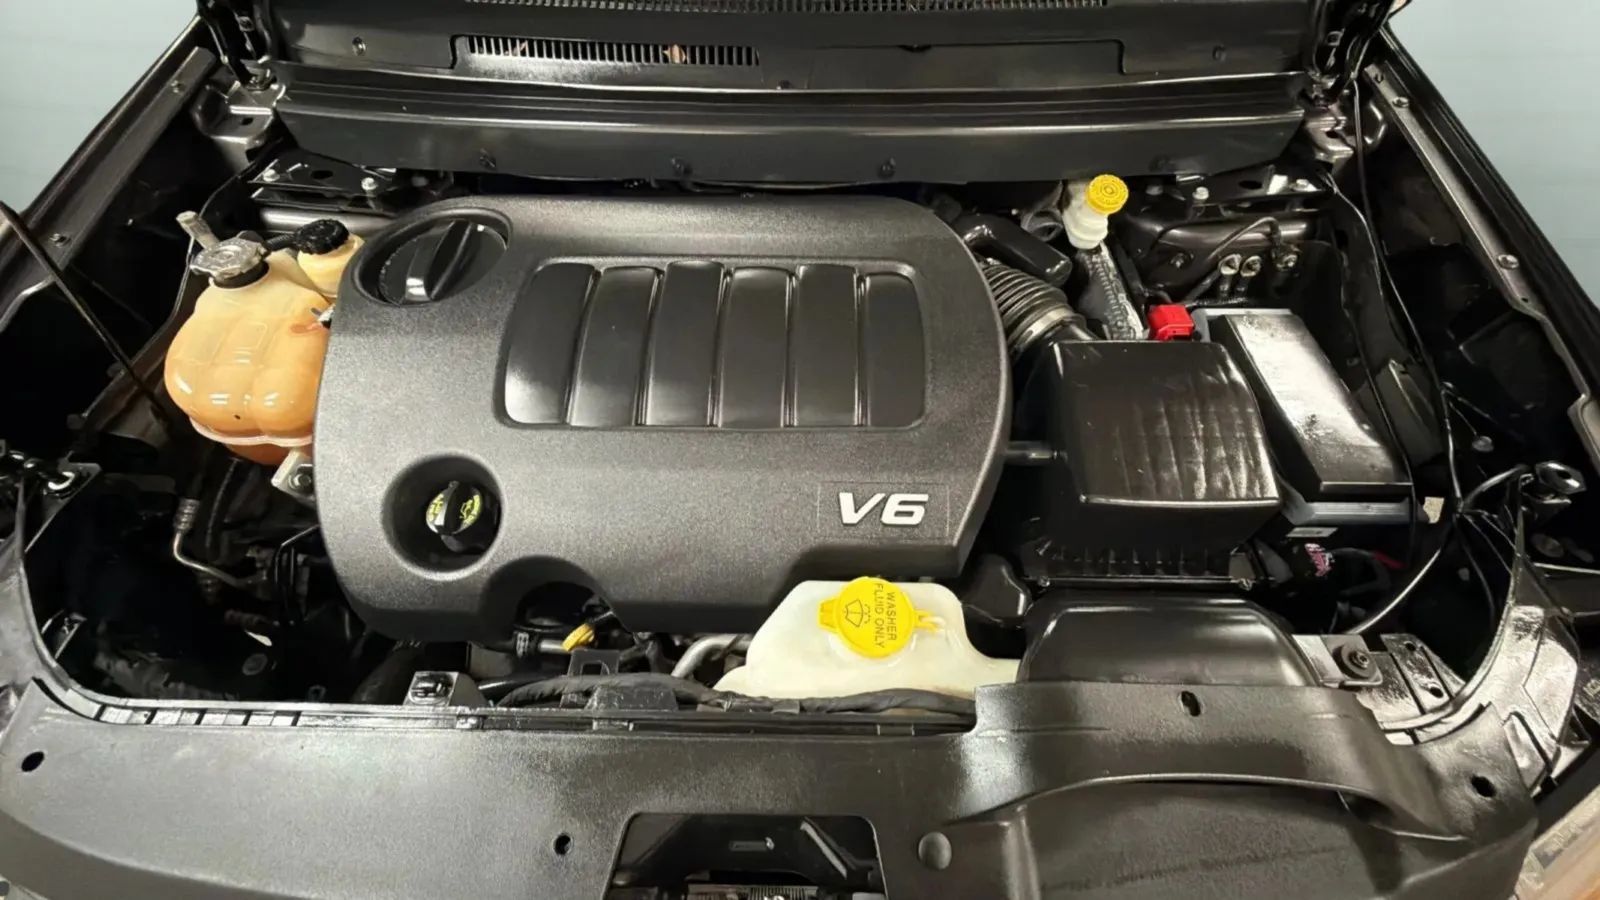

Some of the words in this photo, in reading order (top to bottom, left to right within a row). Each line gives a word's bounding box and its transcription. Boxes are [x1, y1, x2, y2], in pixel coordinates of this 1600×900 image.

[839, 492, 928, 525] V6
[873, 583, 884, 615] FLUID
[874, 617, 885, 648] ONLY
[886, 592, 897, 641] WASHER
